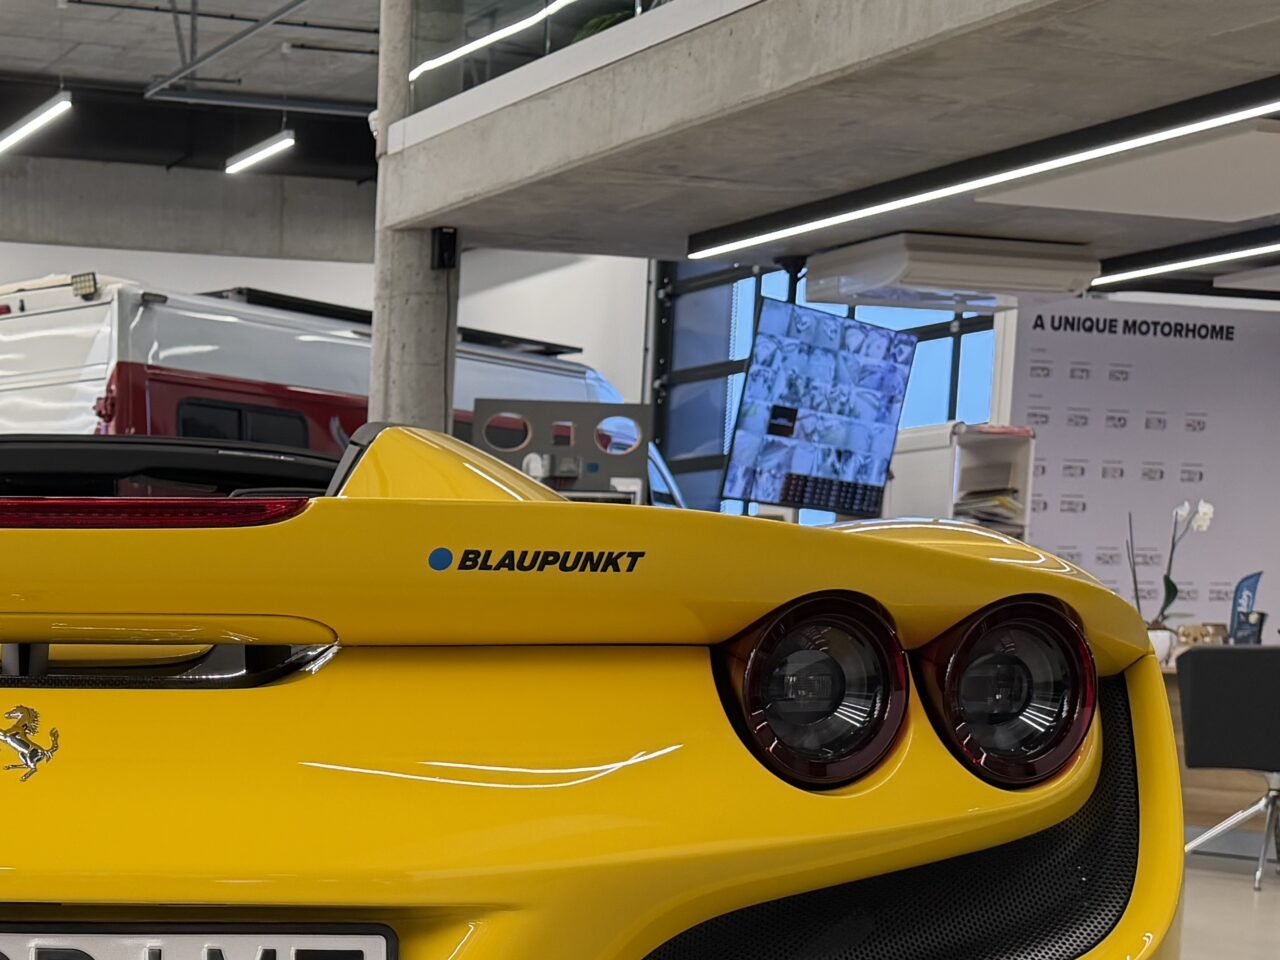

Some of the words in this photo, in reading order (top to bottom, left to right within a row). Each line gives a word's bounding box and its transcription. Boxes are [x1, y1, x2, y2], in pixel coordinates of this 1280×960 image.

[1032, 314, 1045, 331] A
[1051, 316, 1118, 335] UNIQUE
[1123, 320, 1235, 341] MOTORHOME
[457, 549, 646, 573] BLAUPUNKT
